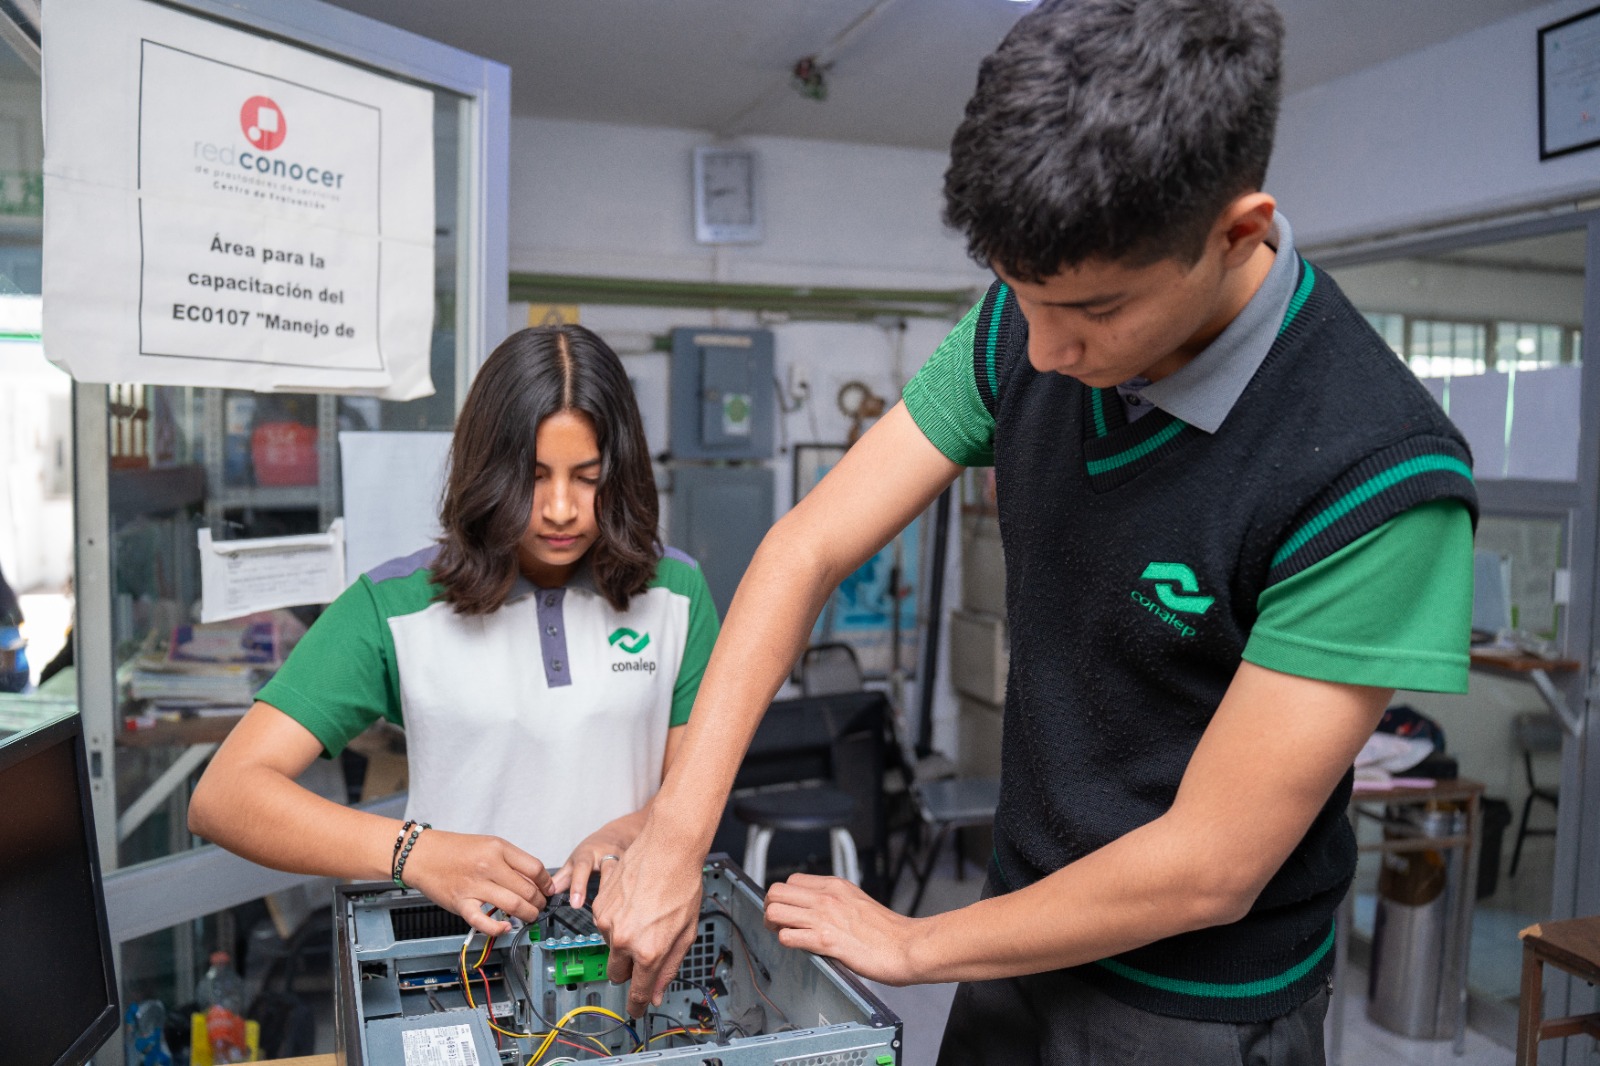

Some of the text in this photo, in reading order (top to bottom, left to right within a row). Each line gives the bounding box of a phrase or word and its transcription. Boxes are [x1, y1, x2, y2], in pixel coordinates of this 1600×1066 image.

[210, 232, 325, 269] Área para la
[188, 272, 344, 304] capacitación del
[172, 303, 355, 338] EC0107 "Manejo de
[1131, 590, 1196, 637] conalep
[611, 657, 656, 675] conalep
